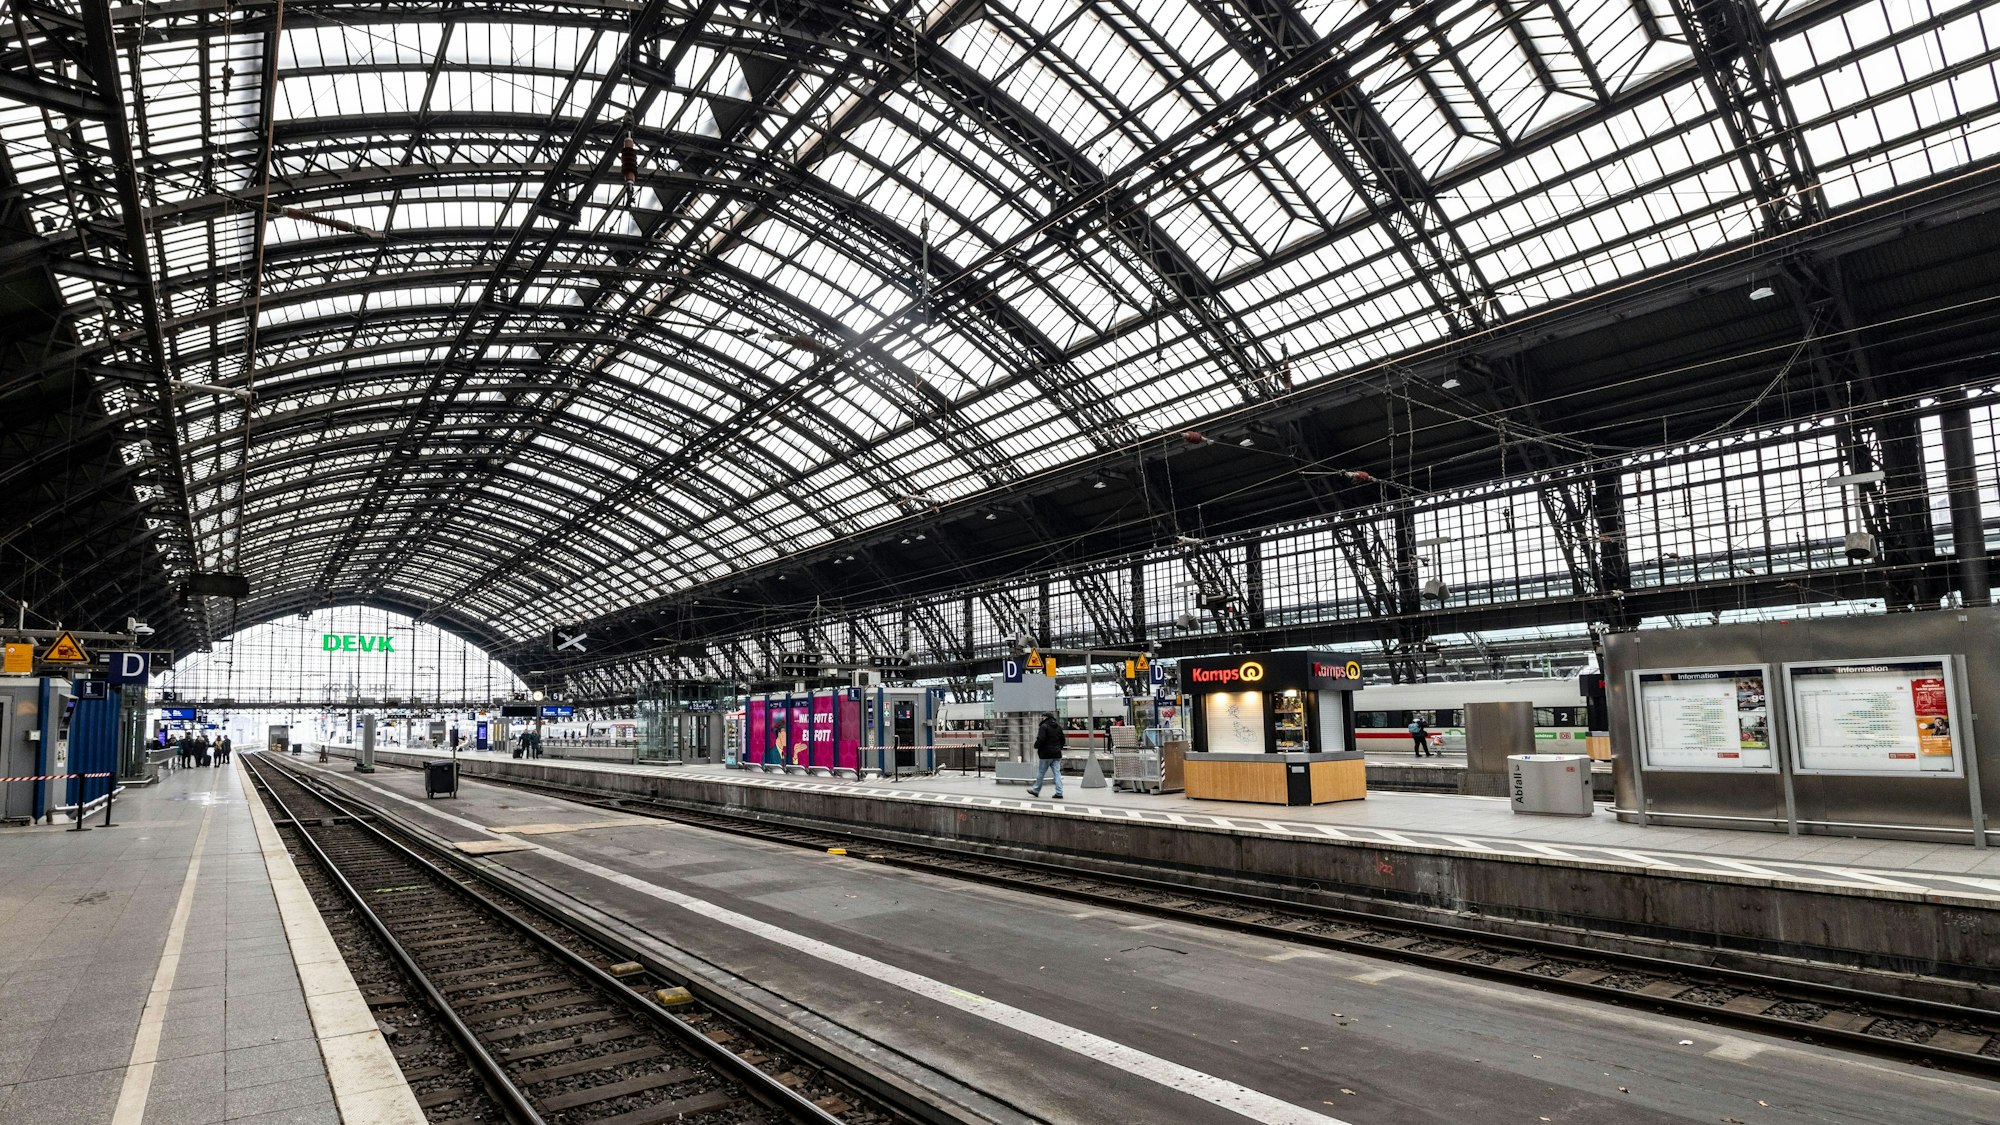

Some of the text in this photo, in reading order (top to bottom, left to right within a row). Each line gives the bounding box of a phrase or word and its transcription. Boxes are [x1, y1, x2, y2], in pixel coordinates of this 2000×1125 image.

[322, 634, 395, 653] DEVK
[121, 652, 145, 677] D
[1007, 660, 1018, 678] D
[1313, 661, 1346, 680] Kamps
[1837, 665, 1889, 673] Information
[1154, 665, 1164, 680] D
[1192, 668, 1240, 684] Kamps
[1677, 672, 1719, 680] Information
[168, 692, 175, 700] 3
[552, 692, 559, 700] 5
[1159, 688, 1165, 698] D
[813, 712, 828, 724] FOTT
[1560, 712, 1568, 722] 2
[814, 729, 832, 742] FOTT
[1513, 772, 1525, 804] Abfall
